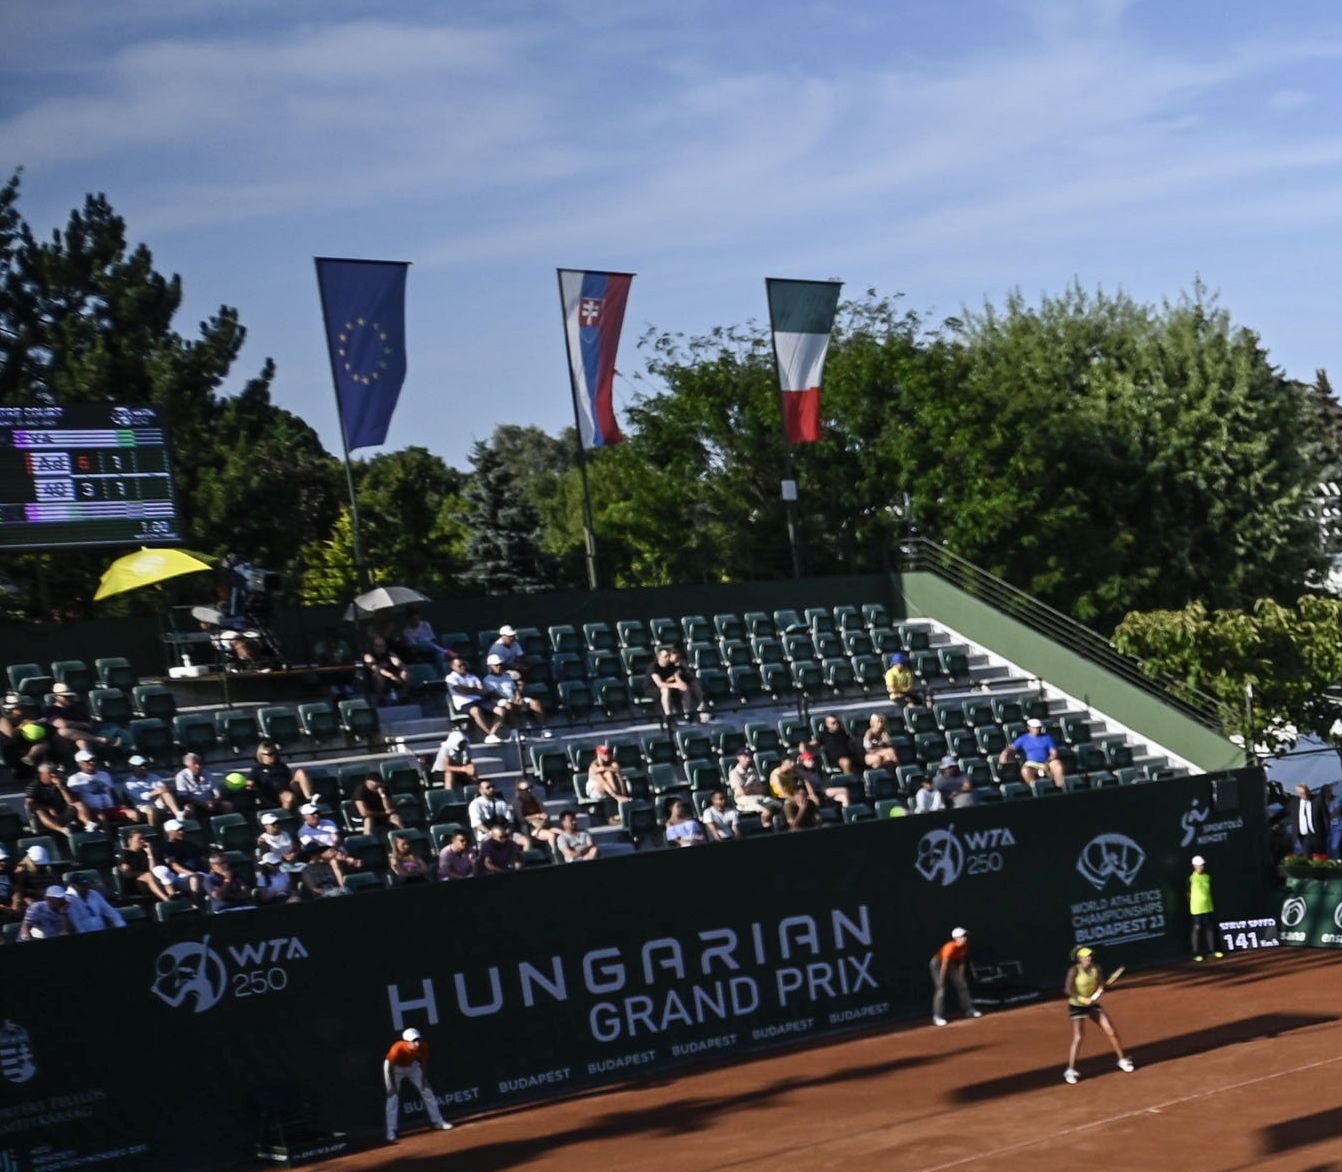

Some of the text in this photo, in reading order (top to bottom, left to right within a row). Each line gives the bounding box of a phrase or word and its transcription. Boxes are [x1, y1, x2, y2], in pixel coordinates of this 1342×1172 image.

[112, 455, 122, 469] 1
[81, 482, 95, 497] 3
[116, 481, 126, 496] 1
[963, 828, 1016, 850] WTA
[966, 852, 1004, 874] 250
[1071, 889, 1162, 914] WORLD ATHLETICS
[1072, 901, 1164, 927] CHAMPIONSHIPS
[1075, 918, 1148, 942] BUDAPEST
[1224, 932, 1258, 950] 141
[228, 936, 309, 967] WTA
[387, 905, 874, 1032] HUNGARIAN
[232, 967, 288, 997] 250
[589, 952, 880, 1042] GRAND PRIX
[403, 1002, 890, 1114] BUAPEST BUDAPEST BUDAPEST BUDAPEST BUDAPEST BUDAPEST
